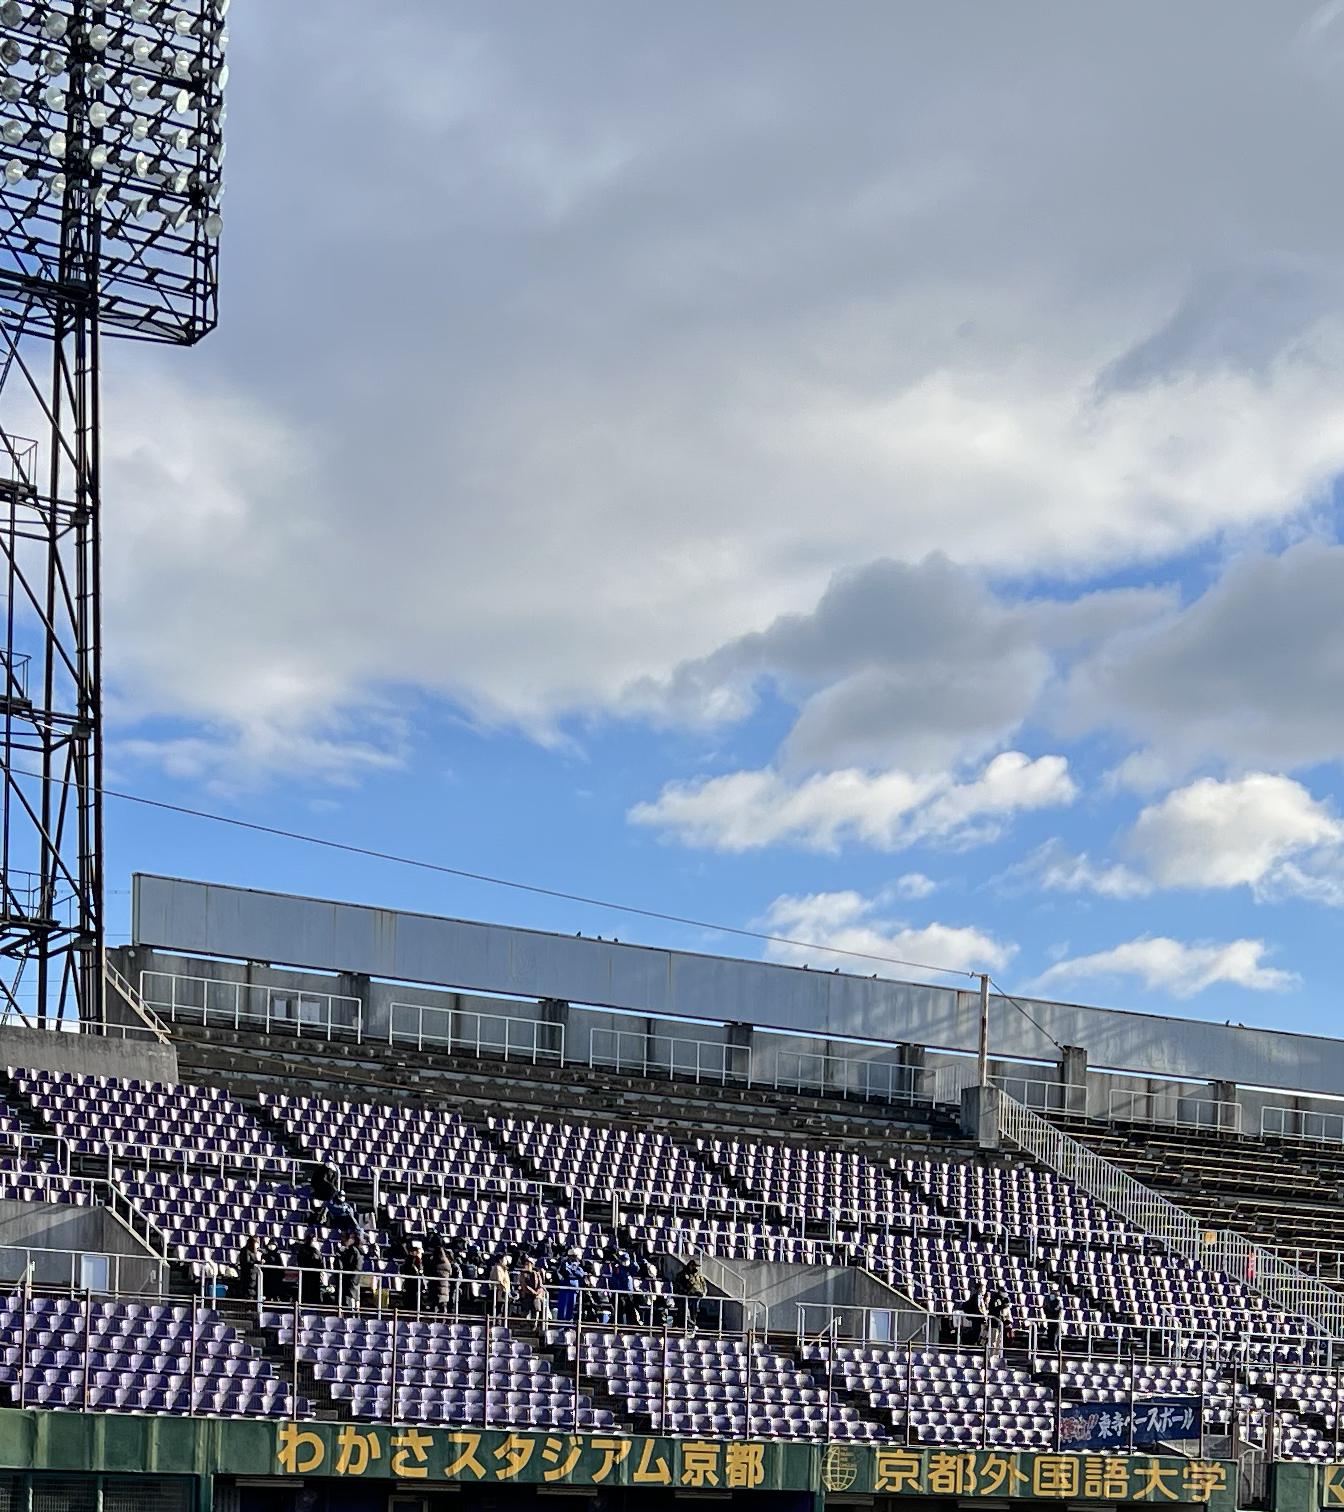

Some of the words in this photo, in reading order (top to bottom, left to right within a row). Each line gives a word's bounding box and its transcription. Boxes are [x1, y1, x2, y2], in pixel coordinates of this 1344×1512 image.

[278, 1423, 765, 1489] わかさスタジアム京都
[875, 1450, 1227, 1502] 京都外国語大学
